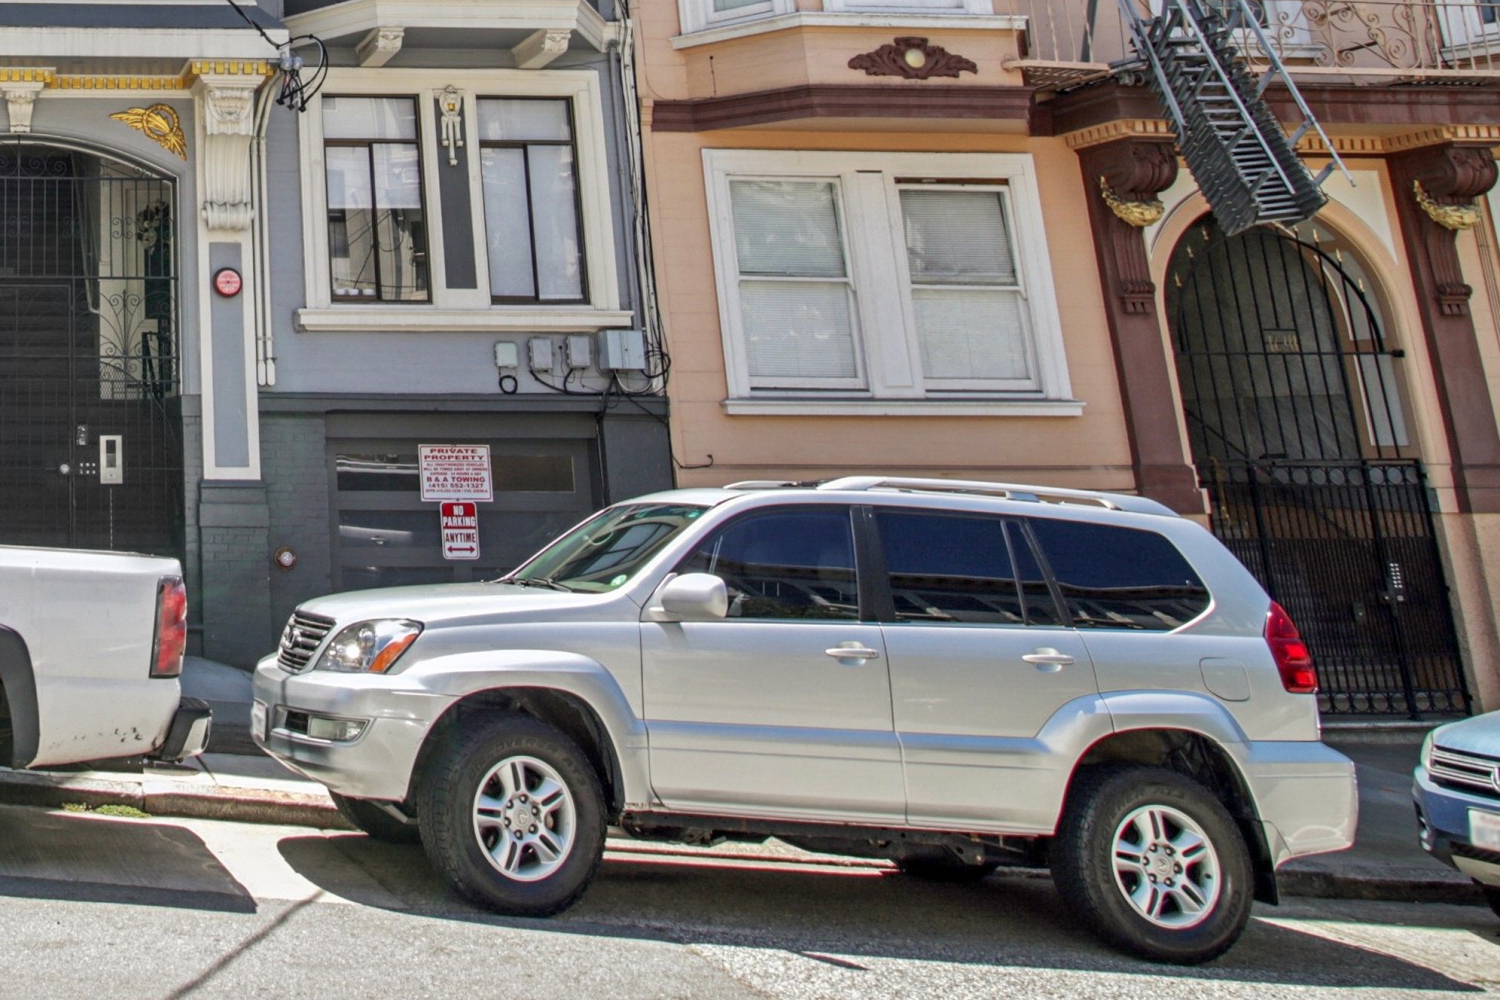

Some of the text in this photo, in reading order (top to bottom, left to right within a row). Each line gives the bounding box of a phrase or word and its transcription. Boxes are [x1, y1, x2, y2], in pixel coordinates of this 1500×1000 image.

[453, 505, 464, 515] NO
[443, 517, 476, 527] PARKING
[445, 532, 476, 543] ANYTIME
